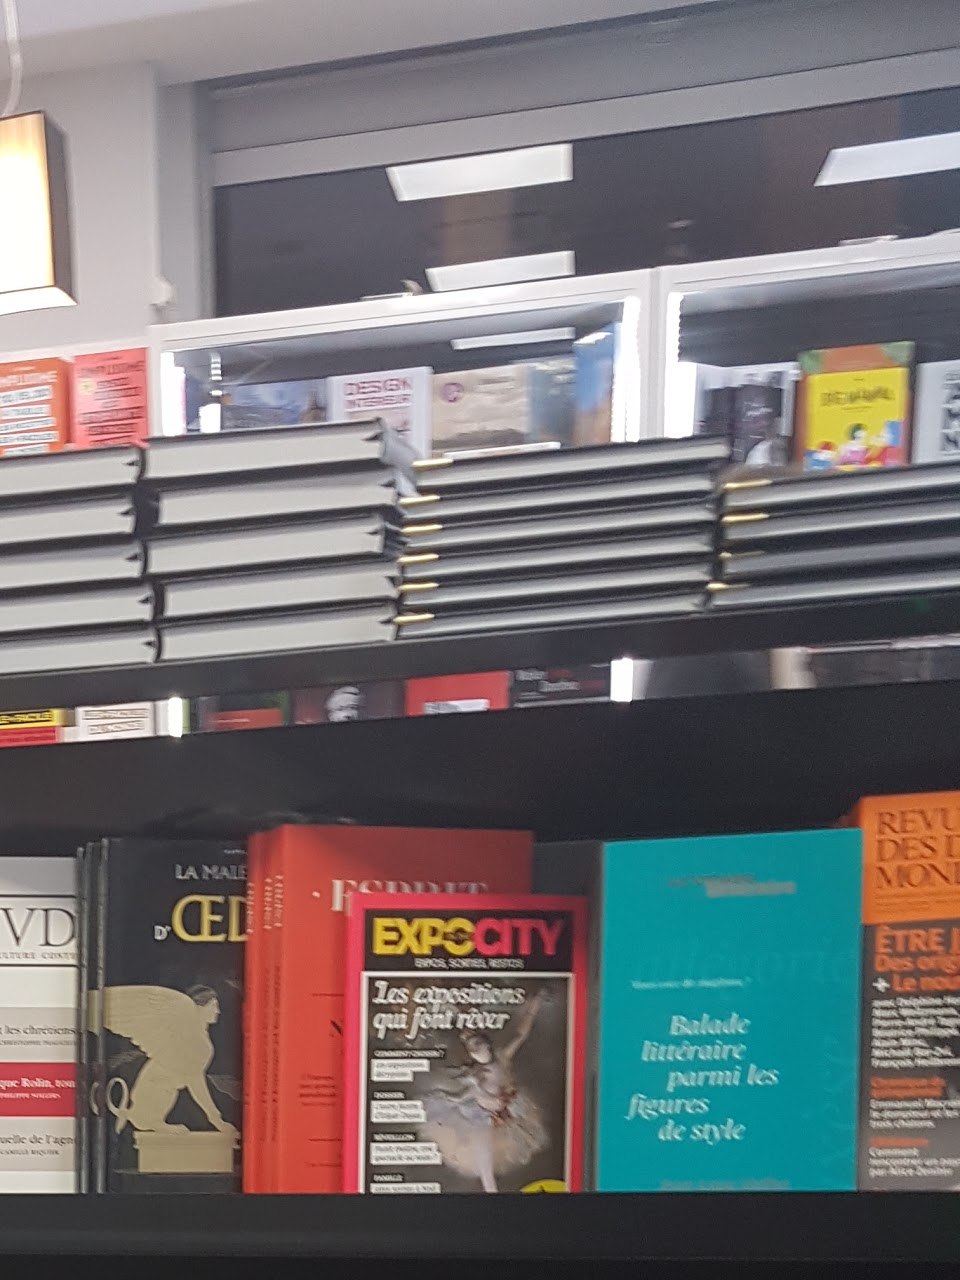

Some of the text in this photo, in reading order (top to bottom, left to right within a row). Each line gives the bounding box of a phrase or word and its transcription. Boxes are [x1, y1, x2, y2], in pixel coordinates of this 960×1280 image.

[372, 982, 525, 1007] Les expositions
[5, 1024, 20, 1034] les
[373, 1009, 508, 1040] qui font rêver
[670, 1014, 751, 1035] Balade
[642, 1042, 746, 1062] littéraire
[667, 1065, 779, 1091] parmi les
[625, 1094, 710, 1120] figures
[30, 1135, 43, 1144] de
[658, 1120, 746, 1144] de style
